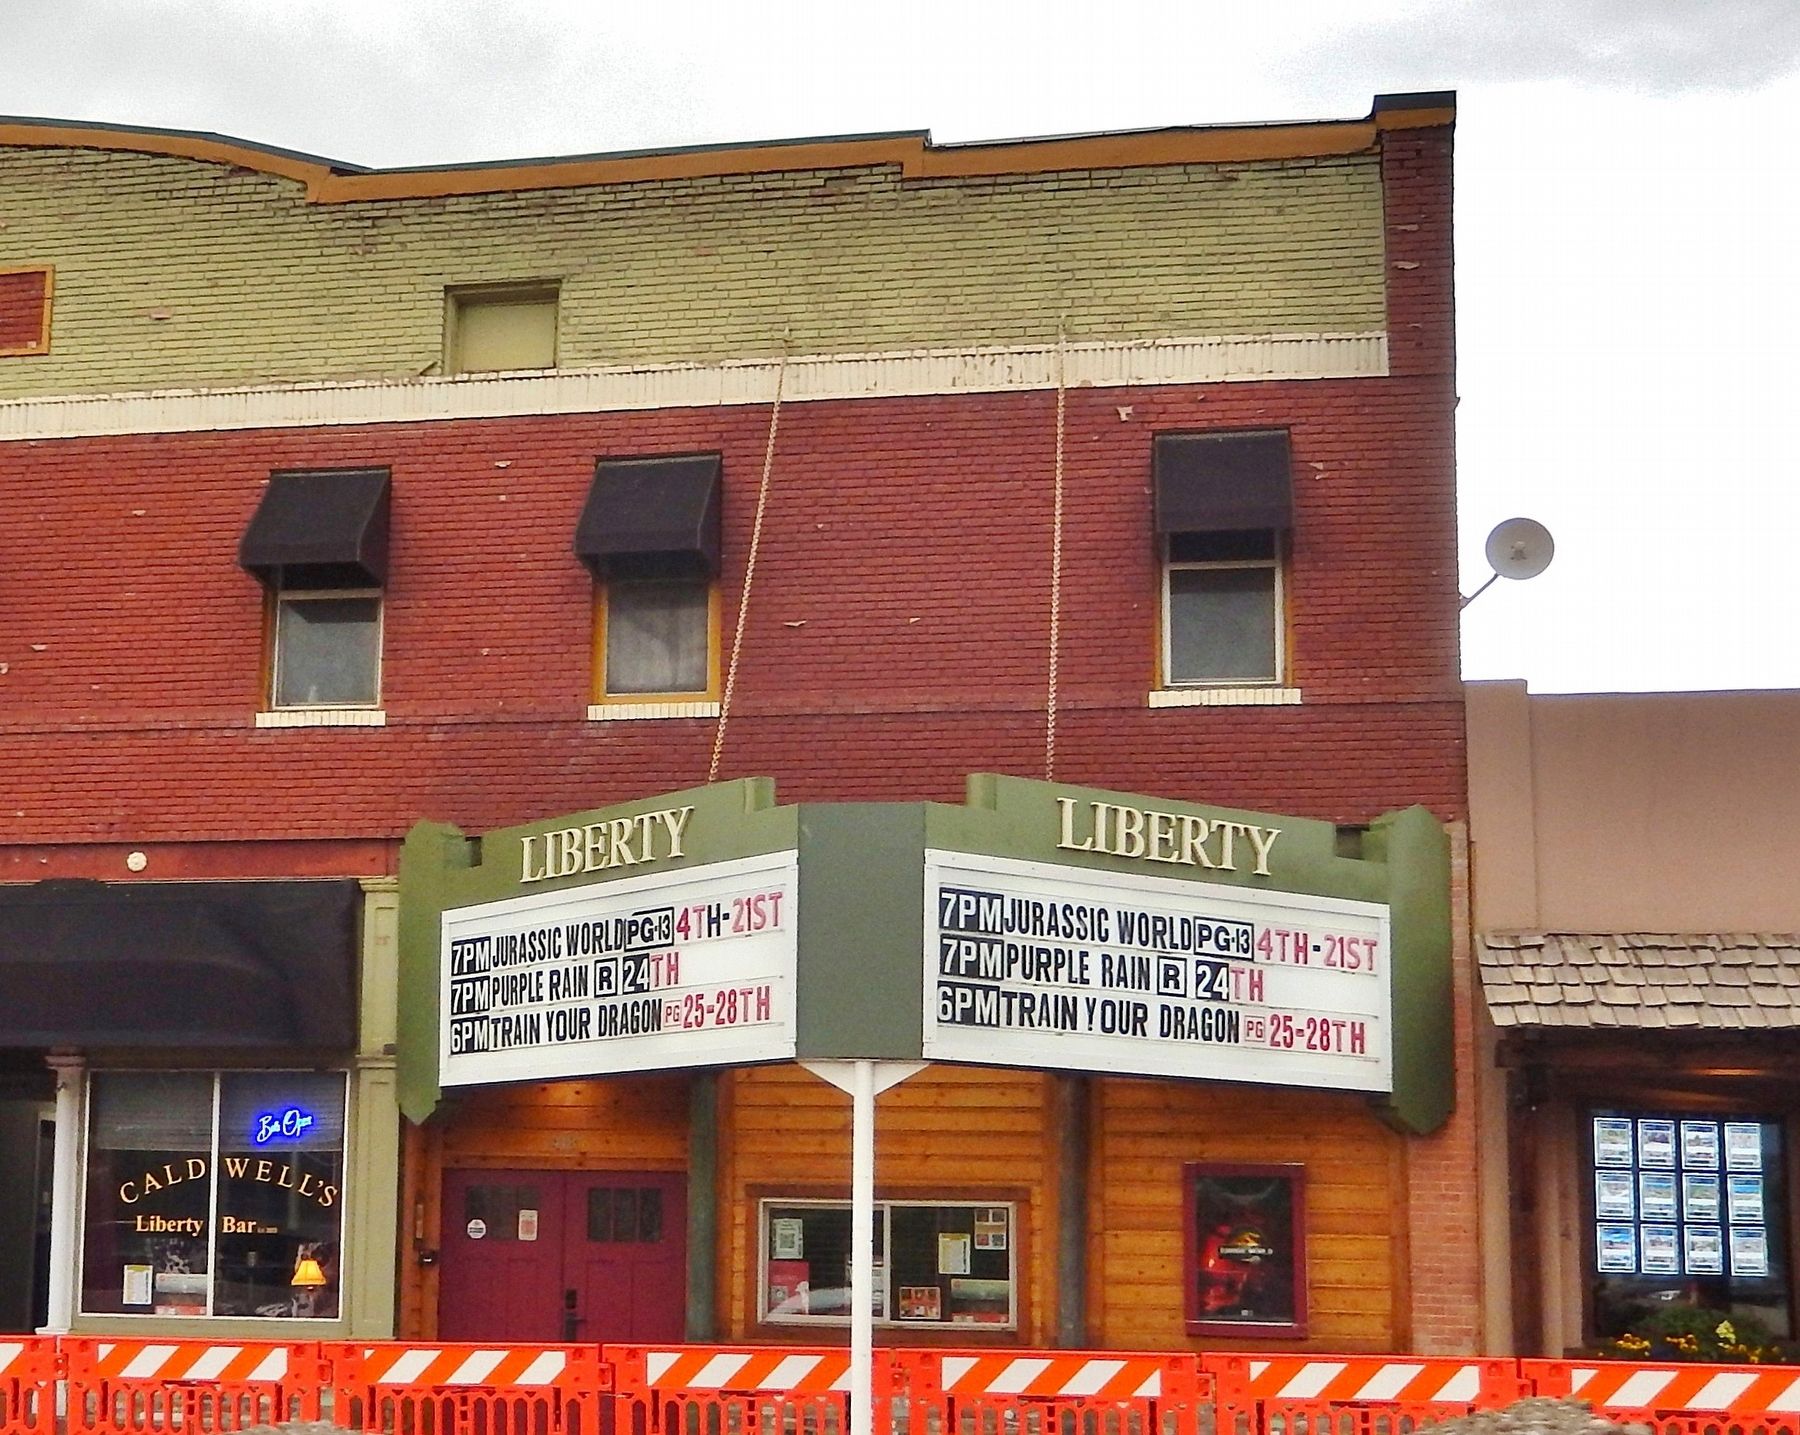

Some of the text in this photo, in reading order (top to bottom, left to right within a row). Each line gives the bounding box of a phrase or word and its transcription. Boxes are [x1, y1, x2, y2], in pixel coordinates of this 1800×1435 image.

[520, 806, 695, 883] LIBERTY
[1056, 797, 1281, 876] LIBERTY
[452, 940, 490, 975] 7PM
[493, 927, 562, 968] JURASSIC
[567, 918, 623, 956] WORLD
[941, 893, 1001, 933] 7PM
[1004, 898, 1109, 943] JURASSIC
[1117, 910, 1191, 950] WORLD
[451, 979, 489, 1014] 7PM
[493, 970, 543, 1007] PURPLE
[550, 965, 588, 1001] RAIN
[598, 966, 612, 991] R
[942, 938, 1002, 979] 7PM
[1007, 943, 1090, 985] PURPLE
[1101, 953, 1150, 990] RAIN
[1163, 963, 1180, 990] R
[451, 1020, 488, 1053] 6PM
[491, 1013, 540, 1048] TRAIN
[546, 1007, 590, 1042] YOUR
[598, 998, 662, 1037] DRAGON
[665, 1004, 680, 1024] PG
[938, 985, 997, 1025] 6PM
[1001, 991, 1077, 1030] TRAIN
[1085, 996, 1148, 1037] YOUR
[1160, 1004, 1239, 1043] DRAGON
[1246, 1020, 1263, 1038] PG
[135, 1215, 203, 1237] Liberty
[222, 1216, 257, 1233] Bar
